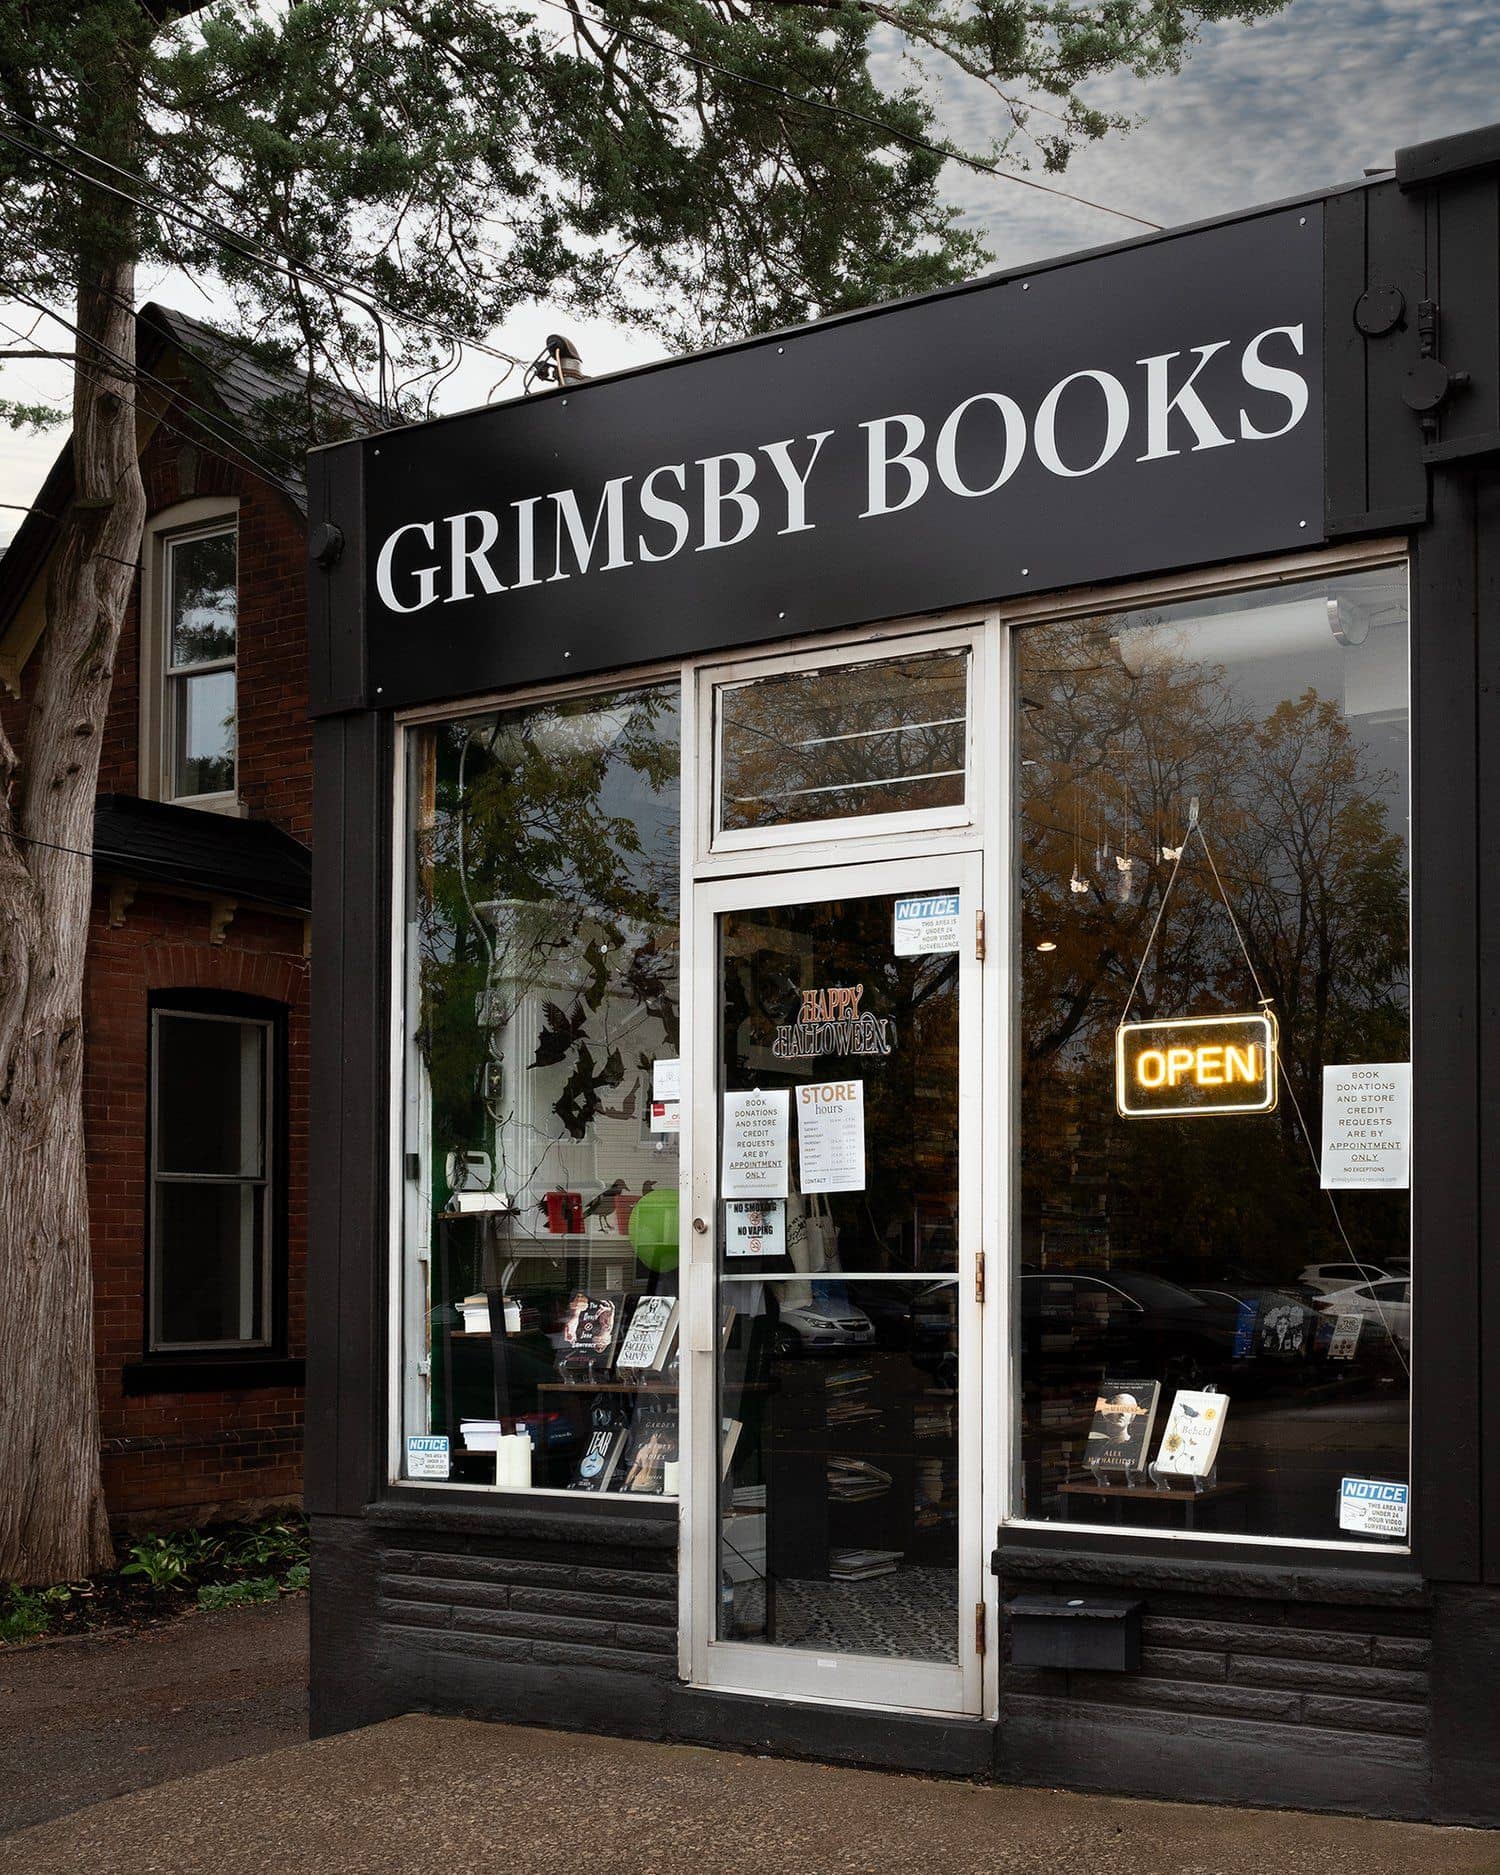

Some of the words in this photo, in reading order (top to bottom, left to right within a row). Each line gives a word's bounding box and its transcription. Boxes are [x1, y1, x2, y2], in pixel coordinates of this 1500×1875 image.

[376, 430, 835, 614] GRIMSBY
[858, 323, 1309, 519] BOOKS
[898, 898, 957, 919] NOTICE
[802, 983, 863, 1023] HAPPY
[773, 1010, 892, 1058] HALLOWEEN
[1136, 1043, 1256, 1088] OPEN
[1351, 1071, 1379, 1079] BOOK
[1336, 1082, 1396, 1091] DONATIONS
[801, 1083, 857, 1105] STORE
[1337, 1095, 1357, 1103] AND
[1361, 1094, 1395, 1102] STORE
[745, 1099, 767, 1107] BOOK
[735, 1108, 778, 1118] DONATIONS
[815, 1103, 844, 1115] hours
[1346, 1106, 1385, 1114] CREDIT
[736, 1120, 751, 1128] AND
[753, 1119, 777, 1127] STORE
[1338, 1118, 1392, 1126] REQUESTS
[1347, 1130, 1366, 1138] ARE
[737, 1139, 775, 1148] REQUESTS
[1329, 1141, 1401, 1150] APPOINTMENT
[742, 1150, 757, 1158] ARE
[759, 1150, 769, 1158] BY
[1351, 1154, 1378, 1162] ONLY
[729, 1160, 783, 1169] APPOINTMENT
[745, 1171, 766, 1179] ONLY
[804, 1177, 827, 1185] CONTACT
[734, 1203, 743, 1213] NO
[744, 1201, 777, 1213] SMOKING
[738, 1226, 747, 1236] NO
[748, 1225, 774, 1235] VAPING
[623, 1342, 655, 1352] FACELESS
[623, 1351, 648, 1361] SAINTS
[410, 1439, 447, 1451] NOTICE
[585, 1431, 613, 1457] TEAR
[1345, 1482, 1404, 1501] NOTICE
[1372, 1510, 1391, 1518] UNDER
[1364, 1523, 1405, 1533] SURVEILLANCE
